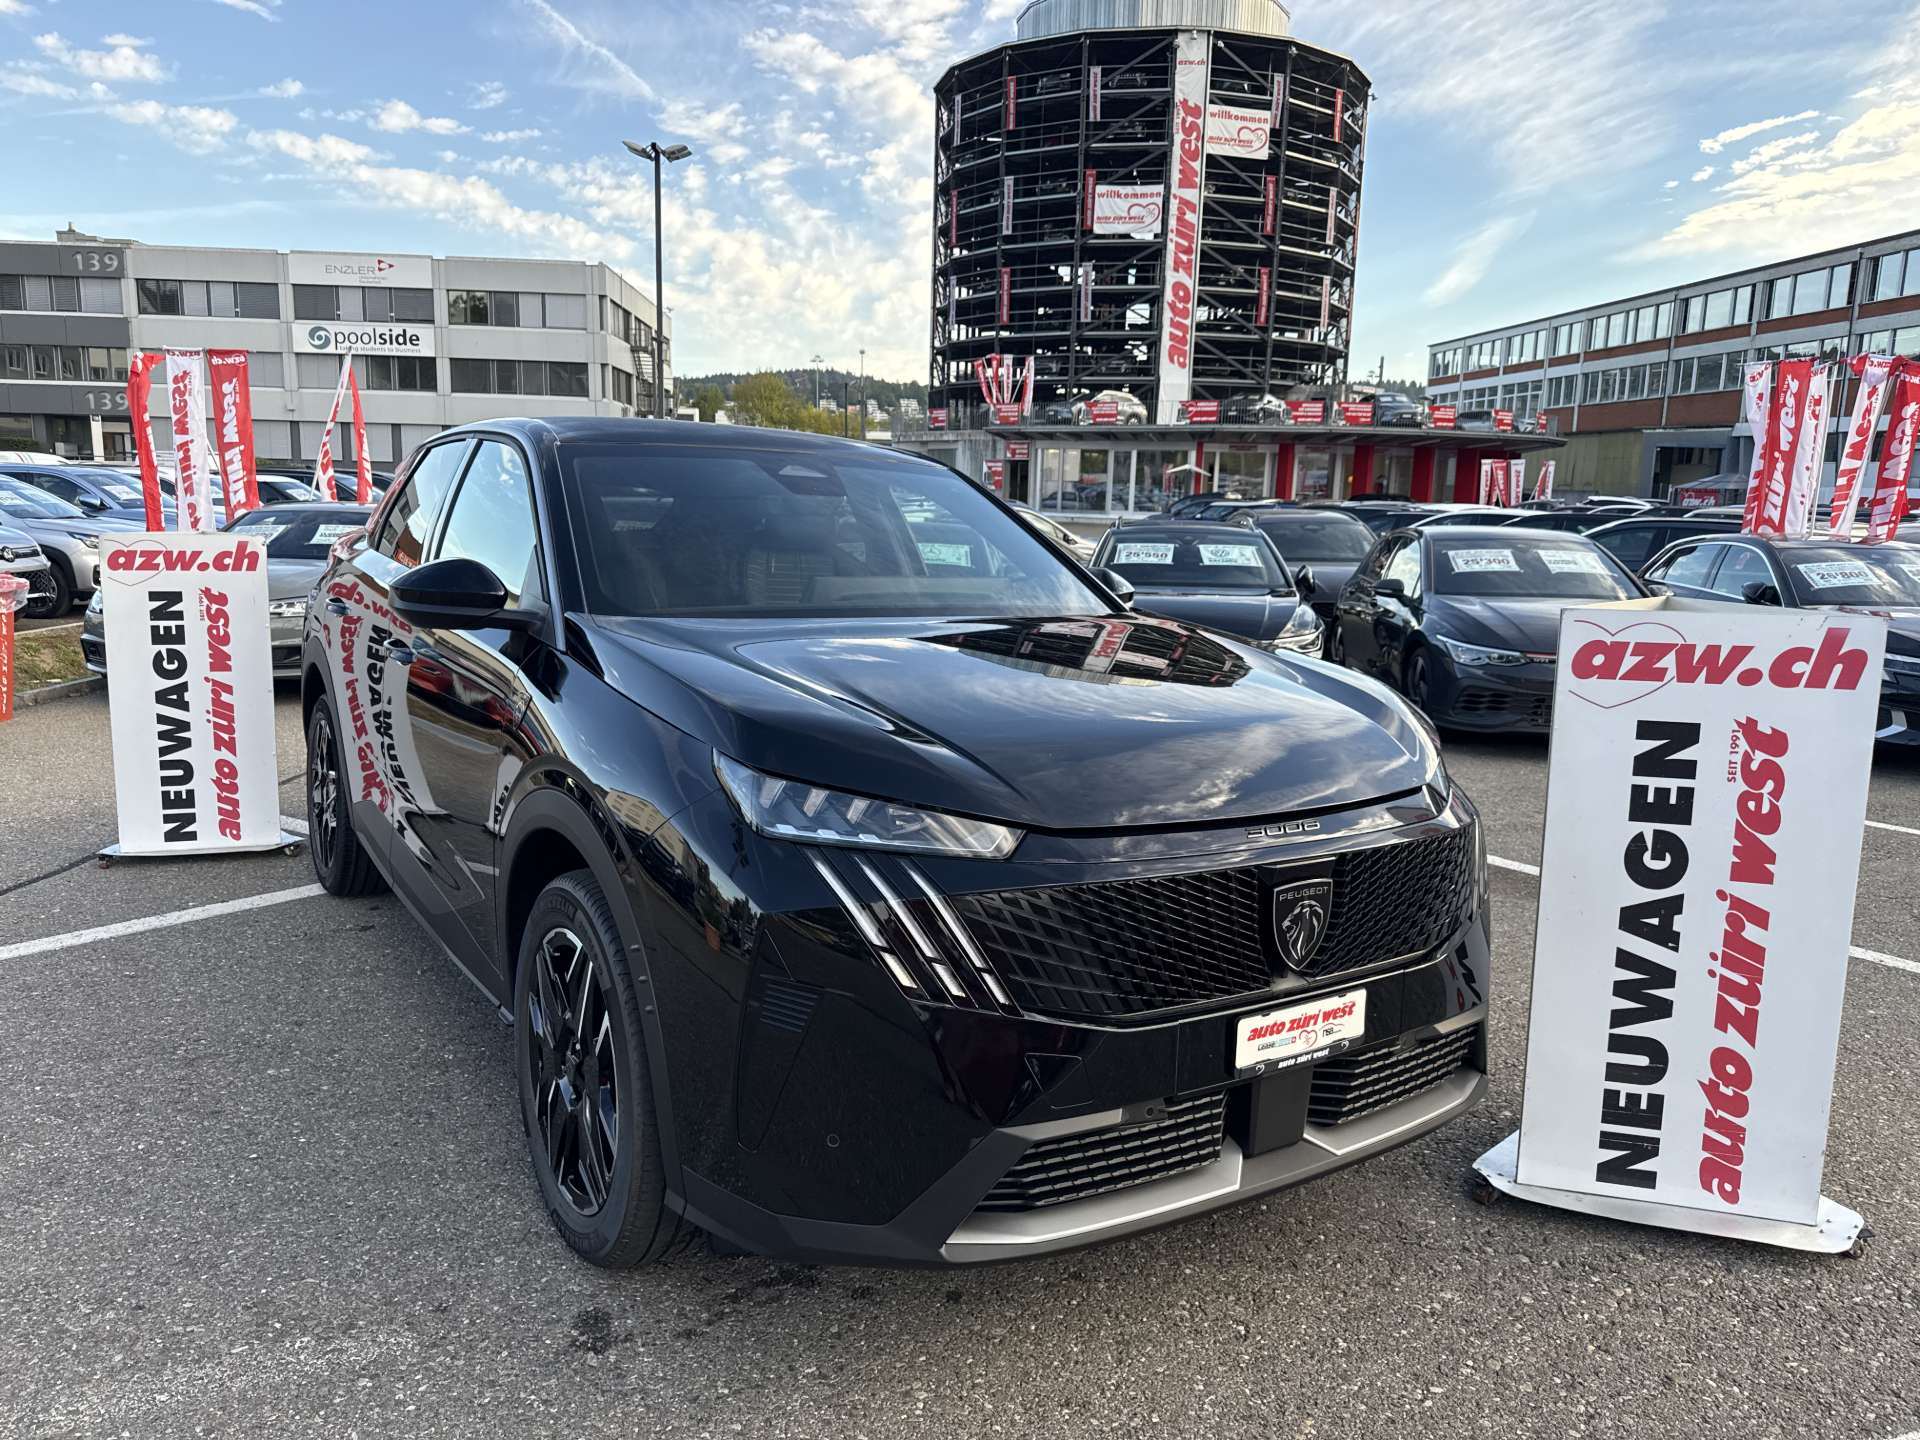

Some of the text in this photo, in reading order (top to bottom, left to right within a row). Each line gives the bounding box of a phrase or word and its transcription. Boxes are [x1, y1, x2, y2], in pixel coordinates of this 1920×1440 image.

[1209, 110, 1269, 124] willkommen
[1096, 189, 1162, 199] willkommen
[1167, 97, 1203, 370] auto züri west
[72, 253, 119, 272] 139
[325, 264, 376, 275] ENZLER
[334, 327, 420, 351] poolside
[84, 392, 129, 410] 139
[1779, 372, 1799, 452] west
[106, 540, 260, 572] azw.ch
[1571, 627, 1868, 690] azw.ch
[148, 590, 198, 842] NEUWAGEN
[199, 586, 241, 841] auto züri west
[1727, 729, 1741, 783] SEIT 1991
[1245, 820, 1321, 838] 3008
[1279, 886, 1329, 901] PEUGEOT
[1595, 719, 1701, 1190] NEUWAGEN
[1696, 715, 1790, 1205] auto züri west
[1247, 1020, 1287, 1042] auto
[1286, 1009, 1322, 1033] züri
[1322, 1001, 1356, 1023] west
[1277, 1058, 1296, 1069] auto
[1312, 1048, 1330, 1059] west
